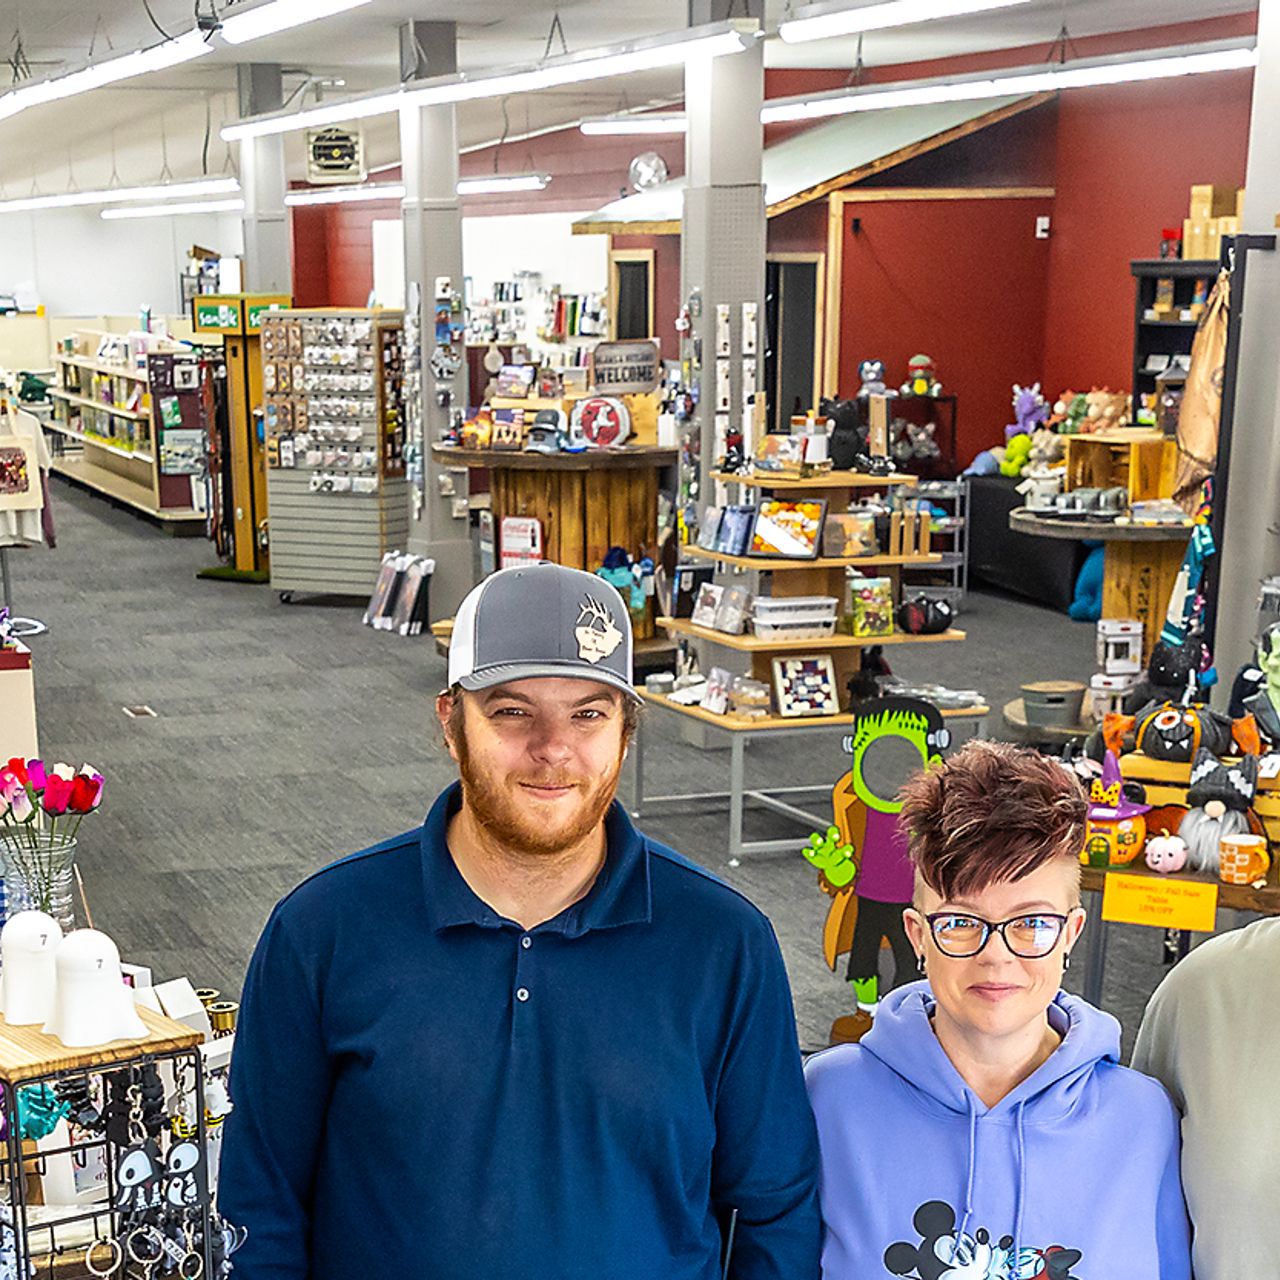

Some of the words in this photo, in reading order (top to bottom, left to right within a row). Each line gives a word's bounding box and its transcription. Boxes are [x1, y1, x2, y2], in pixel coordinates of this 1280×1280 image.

[594, 365, 654, 383] WELCOME
[40, 934, 48, 945] 7
[96, 958, 104, 969] 7
